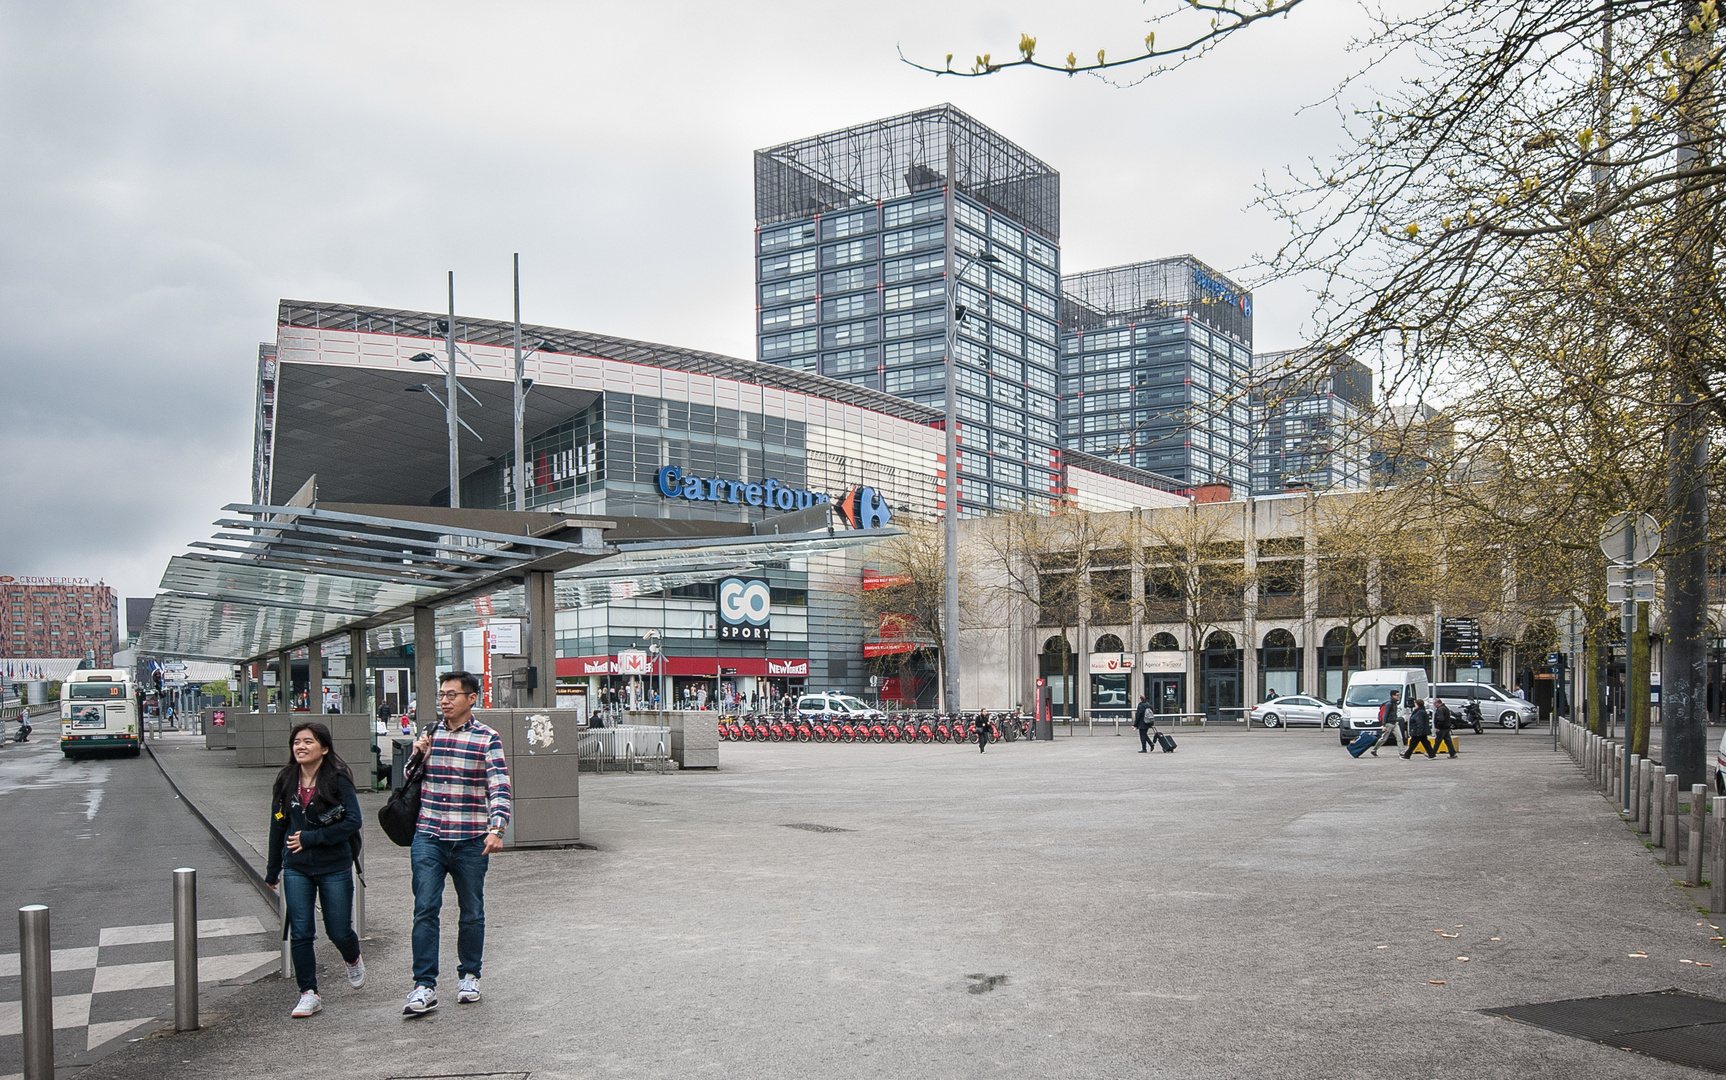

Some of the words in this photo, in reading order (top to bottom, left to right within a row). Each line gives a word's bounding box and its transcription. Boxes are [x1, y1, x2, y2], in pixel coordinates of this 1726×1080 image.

[720, 583, 770, 621] GO
[722, 627, 770, 638] SPORT
[110, 687, 118, 695] 10
